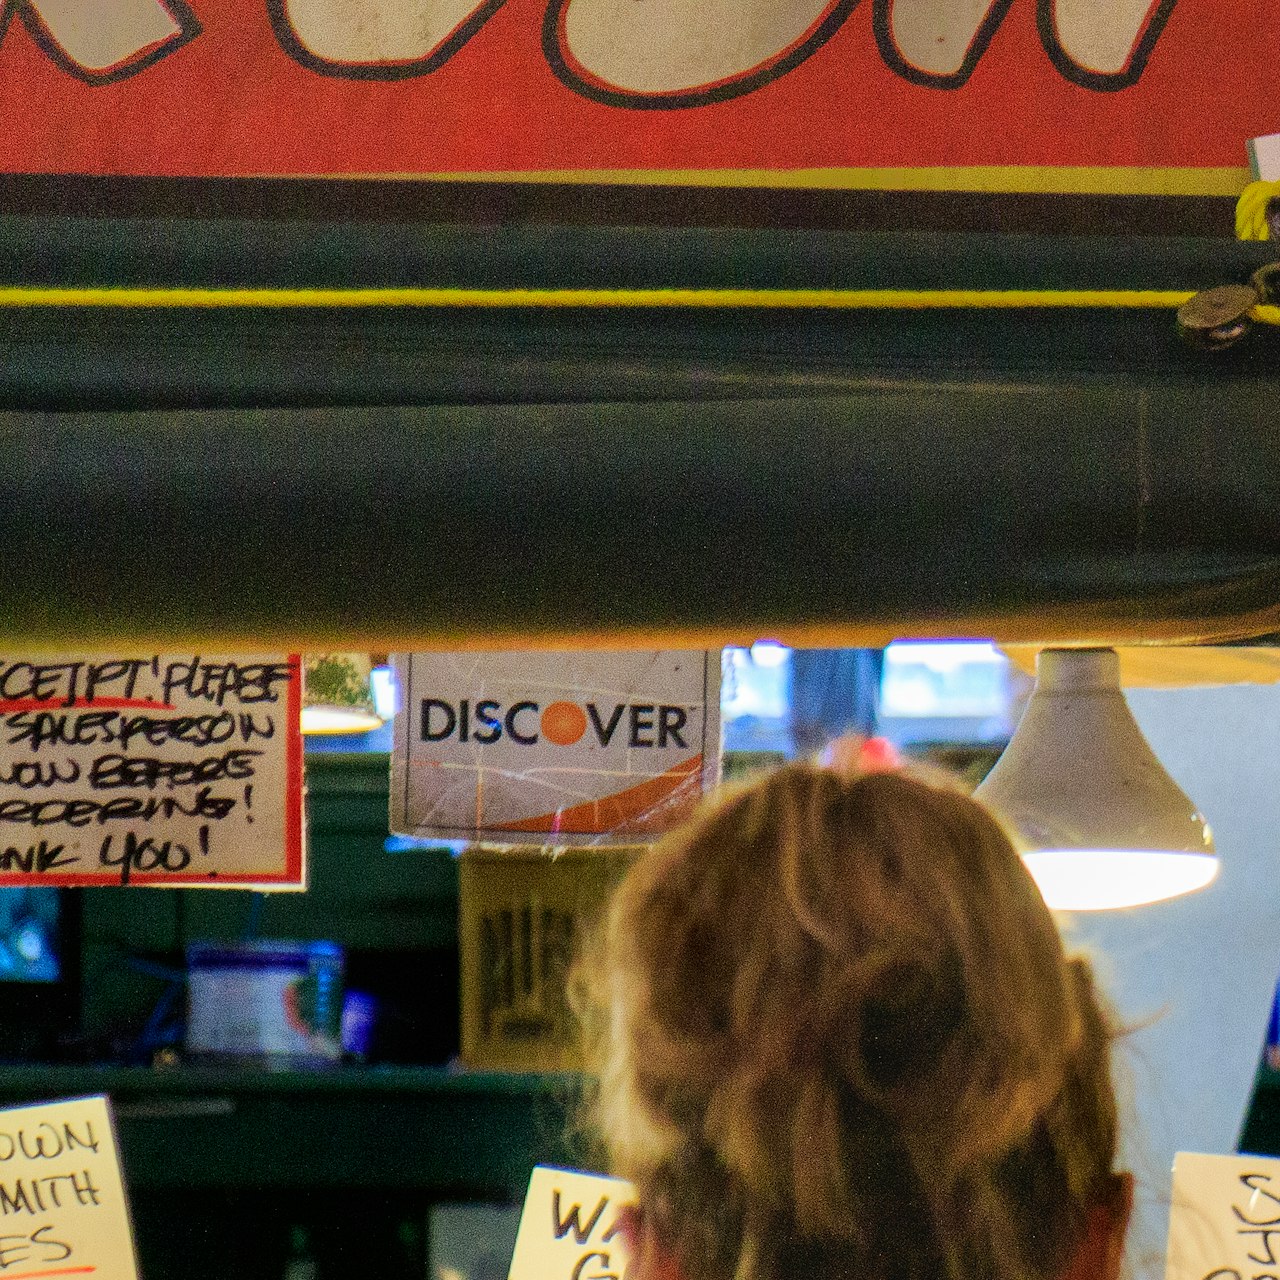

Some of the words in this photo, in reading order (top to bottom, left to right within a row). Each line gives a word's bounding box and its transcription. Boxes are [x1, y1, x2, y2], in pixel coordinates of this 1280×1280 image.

[420, 699, 689, 749] DISCOVER
[90, 751, 264, 789] BEFORE
[100, 825, 218, 884] YOU!
